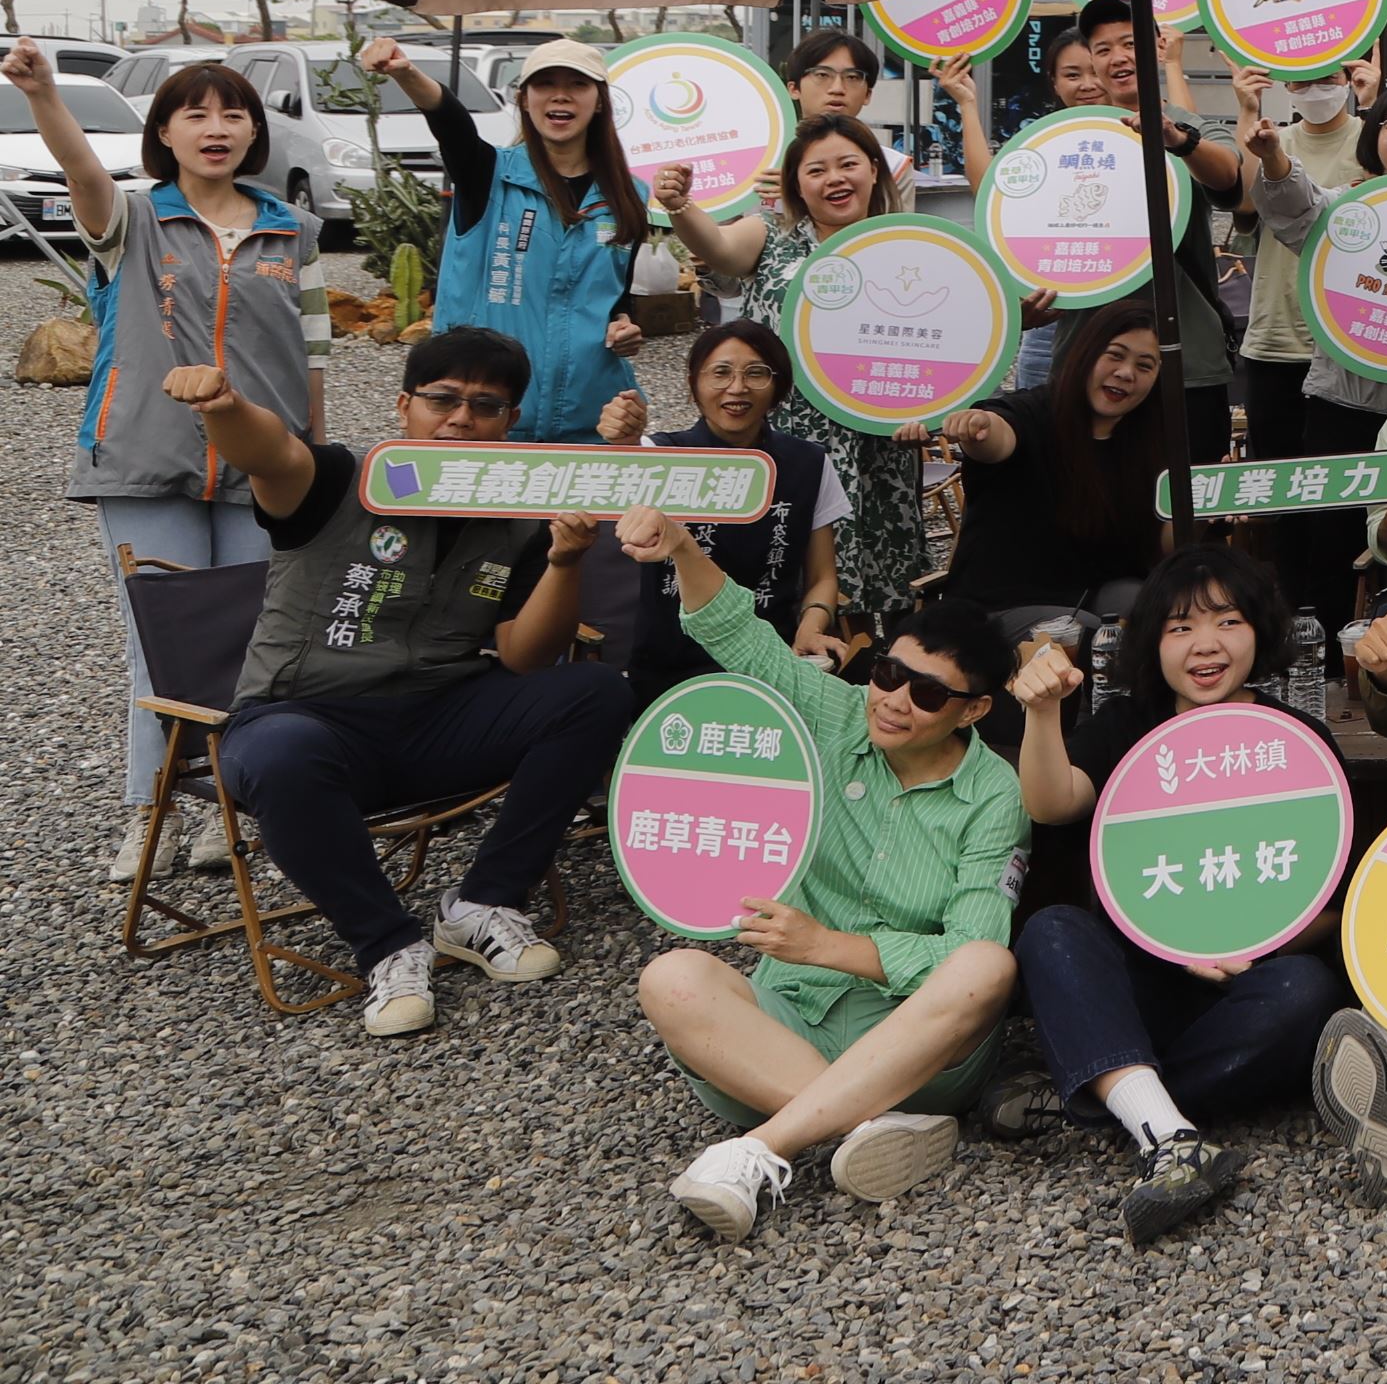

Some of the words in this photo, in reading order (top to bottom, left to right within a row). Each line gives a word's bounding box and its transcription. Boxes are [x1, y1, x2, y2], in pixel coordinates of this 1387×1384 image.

[936, 8, 997, 45] 青創培力站
[1284, 13, 1326, 35] 嘉義縣
[1274, 27, 1344, 54] 青創培力站
[1057, 153, 1116, 171] 鯛魚燒
[1054, 241, 1100, 256] 嘉義縣
[1037, 258, 1113, 273] 青創培力站
[1356, 273, 1382, 293] PRO
[857, 322, 943, 340] 星美國際美容
[869, 361, 921, 379] 嘉義縣
[850, 379, 935, 399] 青創培力站
[427, 459, 757, 511] 嘉義創業新風潮
[1190, 461, 1381, 510] 創業培力
[326, 562, 378, 647] 蔡承佑
[696, 722, 782, 762] 鹿草鄉
[1185, 738, 1288, 784] 大林鎮
[626, 810, 794, 866] 鹿草青平台
[1141, 838, 1299, 900] 大林好
